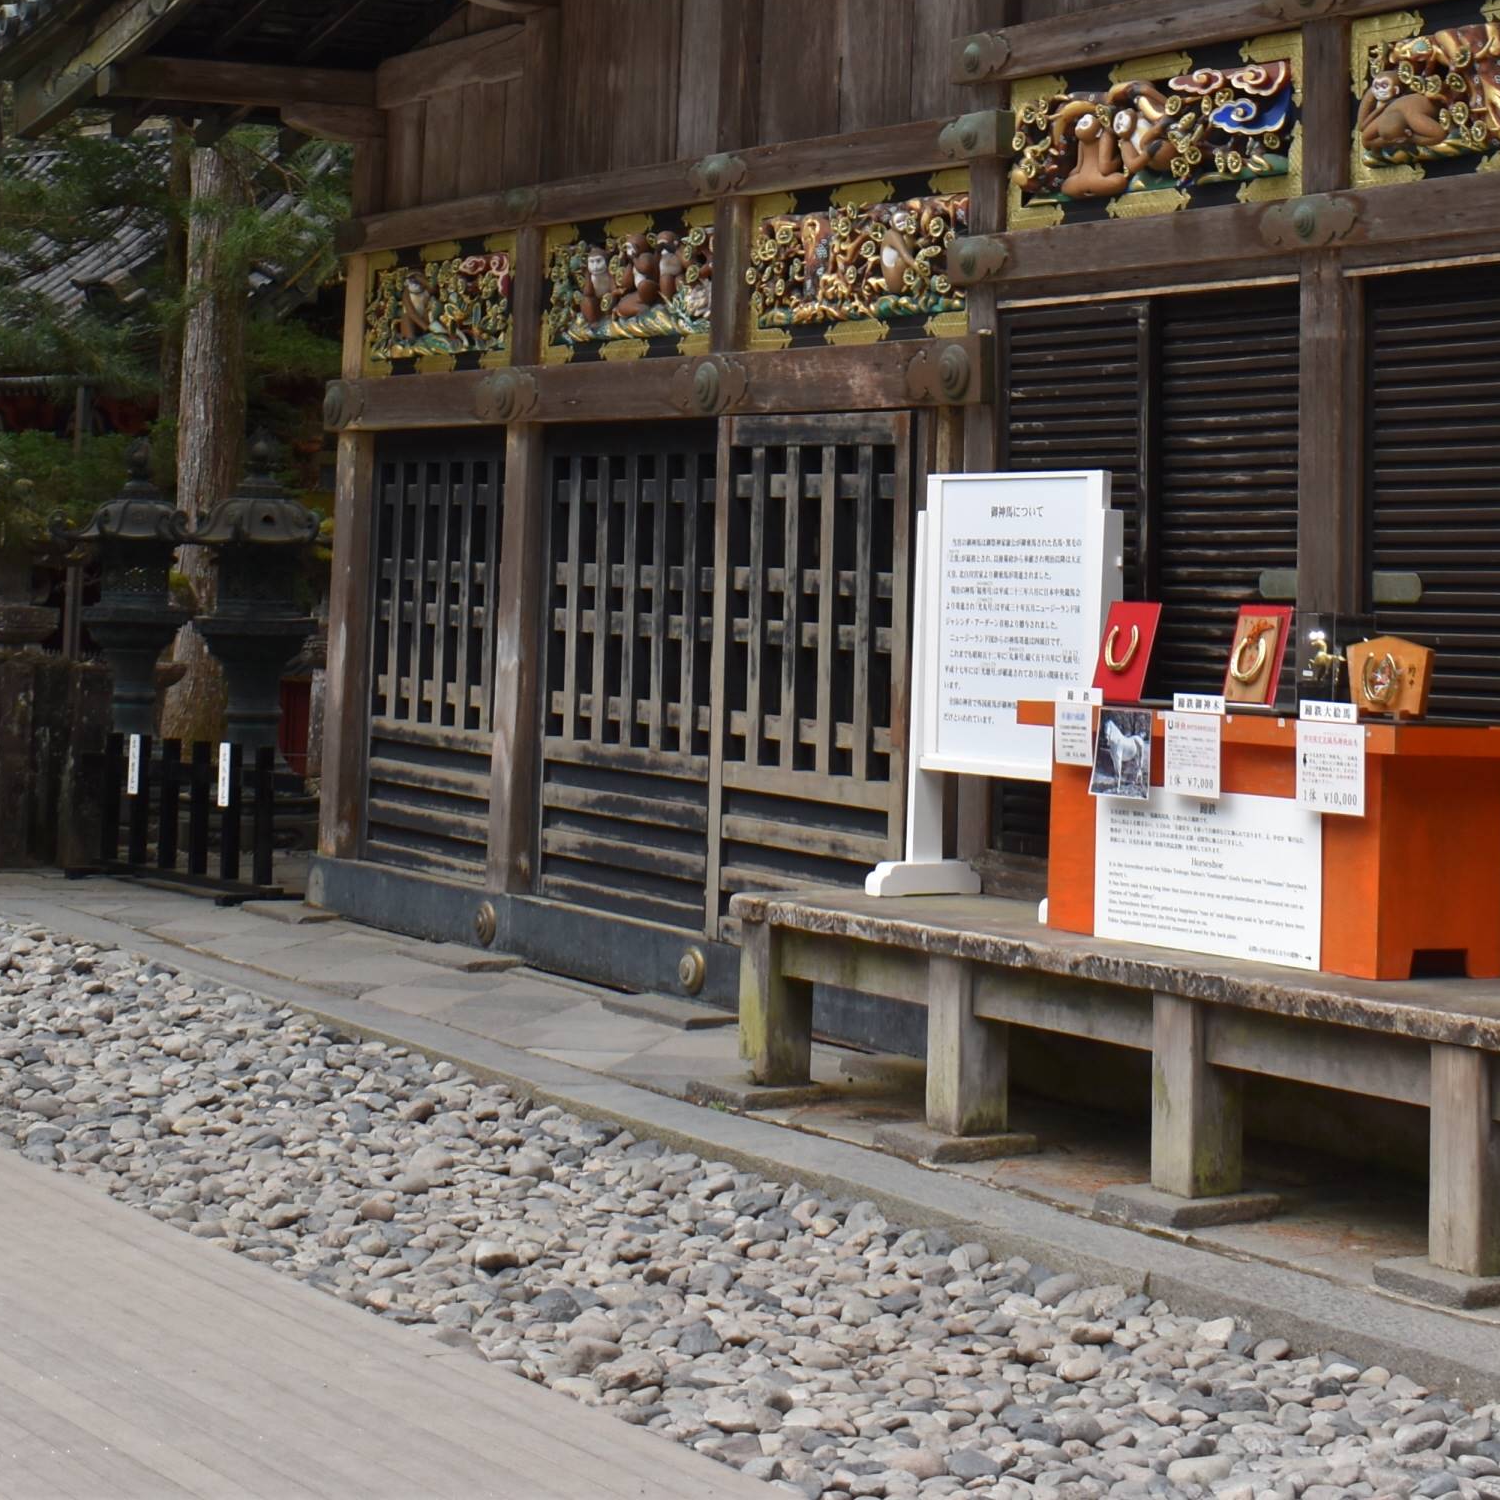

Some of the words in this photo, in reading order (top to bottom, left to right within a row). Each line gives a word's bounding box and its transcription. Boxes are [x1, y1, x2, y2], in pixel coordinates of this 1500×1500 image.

[990, 506, 1044, 518] 御神馬について
[1178, 698, 1220, 710] 蹄鉄御神木
[1304, 704, 1351, 719] 蹄鉄大絵馬
[1170, 772, 1181, 787] 1体
[1188, 777, 1214, 790] ¥7,000
[1304, 788, 1316, 803] 1体
[1324, 792, 1358, 806] ¥10,000
[1191, 857, 1224, 870] Horseshoe
